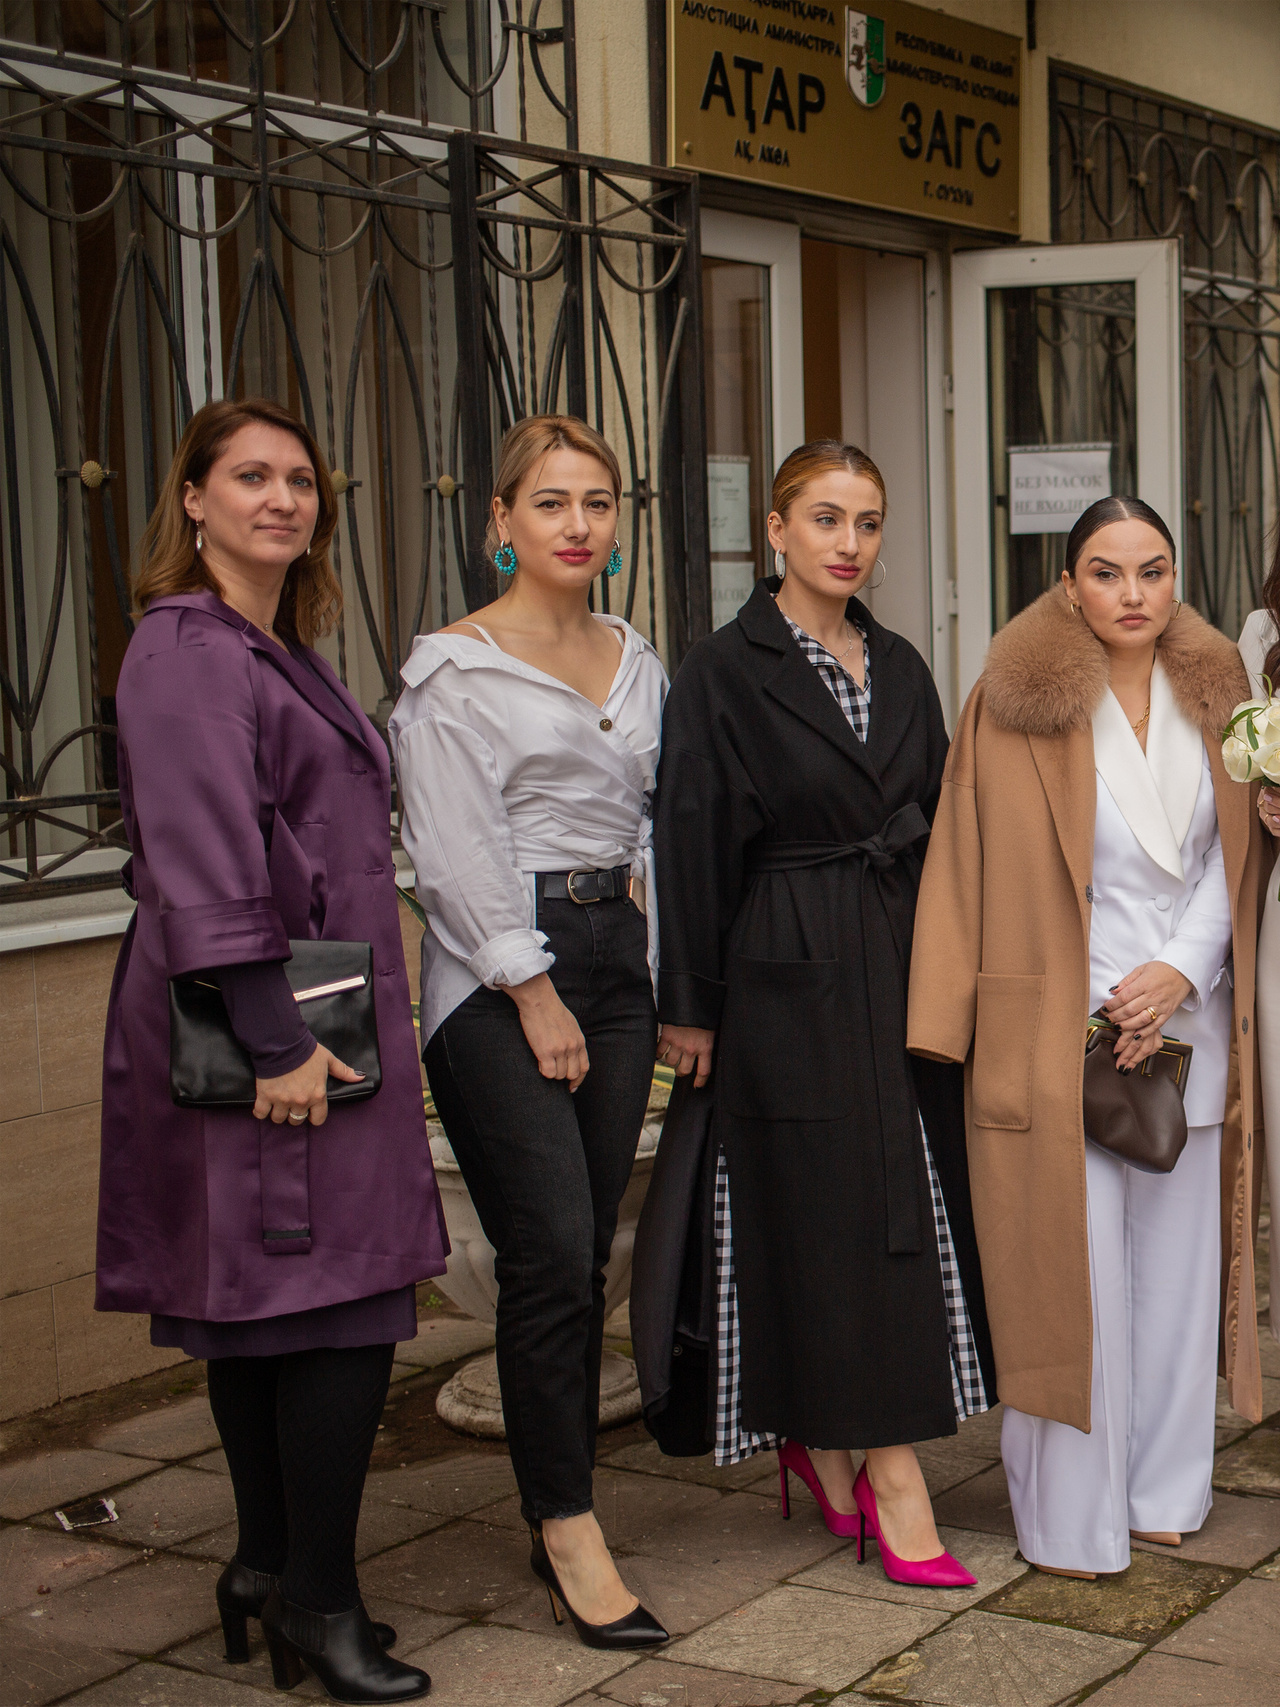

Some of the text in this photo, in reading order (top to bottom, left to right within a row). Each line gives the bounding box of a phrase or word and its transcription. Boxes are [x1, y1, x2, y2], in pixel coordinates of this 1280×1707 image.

[682, 0, 842, 57] АИУСТИЦИА АМИНИСТРРА
[900, 101, 1001, 178] ЗАГС
[1014, 474, 1103, 489] БЕЗ МАСОК
[1014, 499, 1032, 513] НЕ
